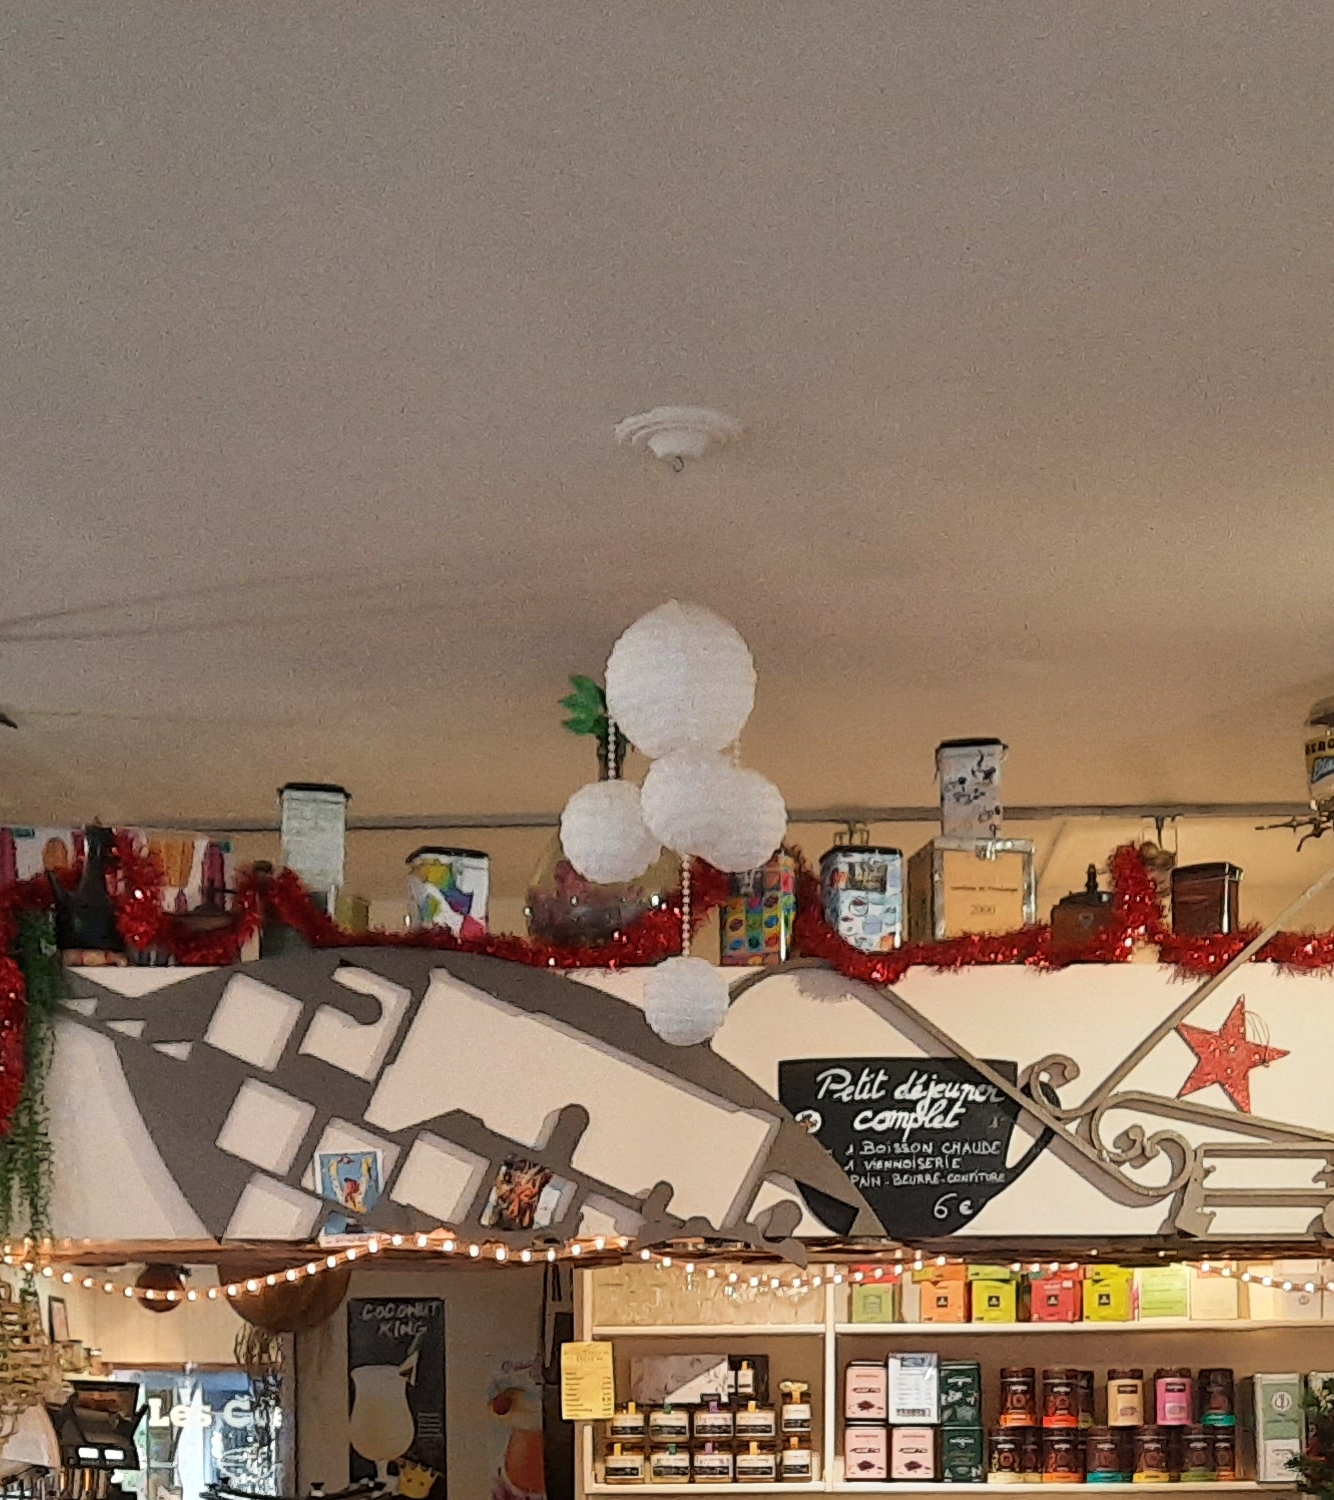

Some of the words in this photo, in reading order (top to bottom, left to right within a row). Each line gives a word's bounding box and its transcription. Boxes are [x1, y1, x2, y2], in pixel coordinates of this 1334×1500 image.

[816, 1067, 889, 1100] Petit
[853, 1100, 966, 1142] complet
[941, 1141, 1002, 1155] CHAUDE
[362, 1301, 439, 1321] COCONUT
[378, 1320, 427, 1337] KING
